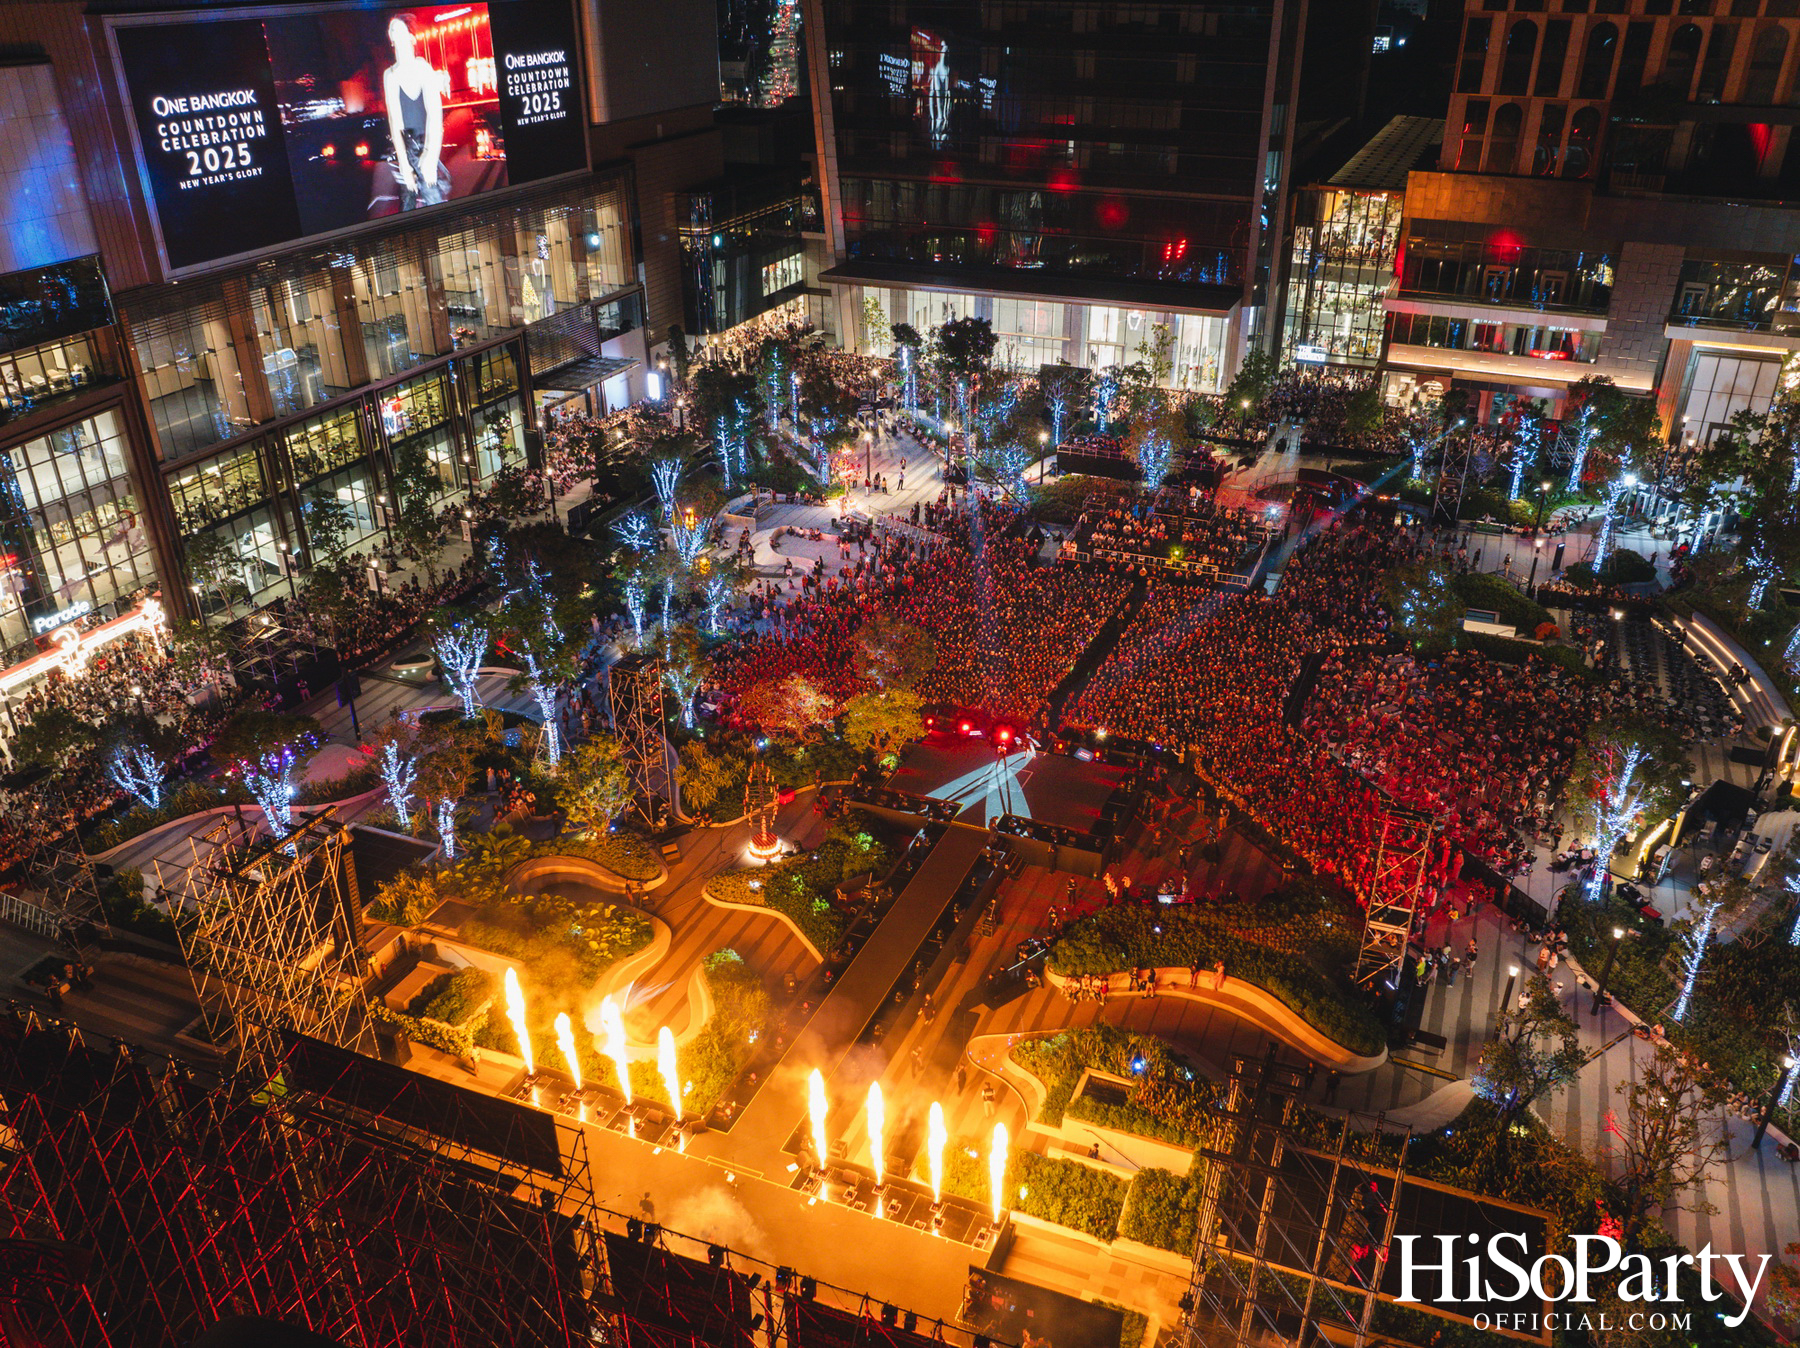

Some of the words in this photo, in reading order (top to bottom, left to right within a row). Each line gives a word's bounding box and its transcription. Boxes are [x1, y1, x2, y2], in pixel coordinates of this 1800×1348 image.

[505, 53, 526, 70] ONE
[526, 51, 566, 67] BANGKOK
[507, 66, 569, 85] COUNTDOWN
[508, 78, 570, 96] CELEBRATION
[152, 96, 189, 117] ONE
[189, 89, 257, 112] BANGKOK
[522, 91, 560, 115] 2025
[158, 110, 264, 137] COUNTDOWN
[516, 118, 529, 126] NEW
[530, 114, 549, 123] YEAR'S
[549, 111, 567, 120] GLORY
[161, 124, 266, 152] CELEBRATION
[186, 142, 252, 176] 2025
[179, 179, 200, 190] NEW
[202, 173, 234, 186] YEAR'S
[235, 167, 263, 179] GLORY
[33, 600, 91, 634] Parade
